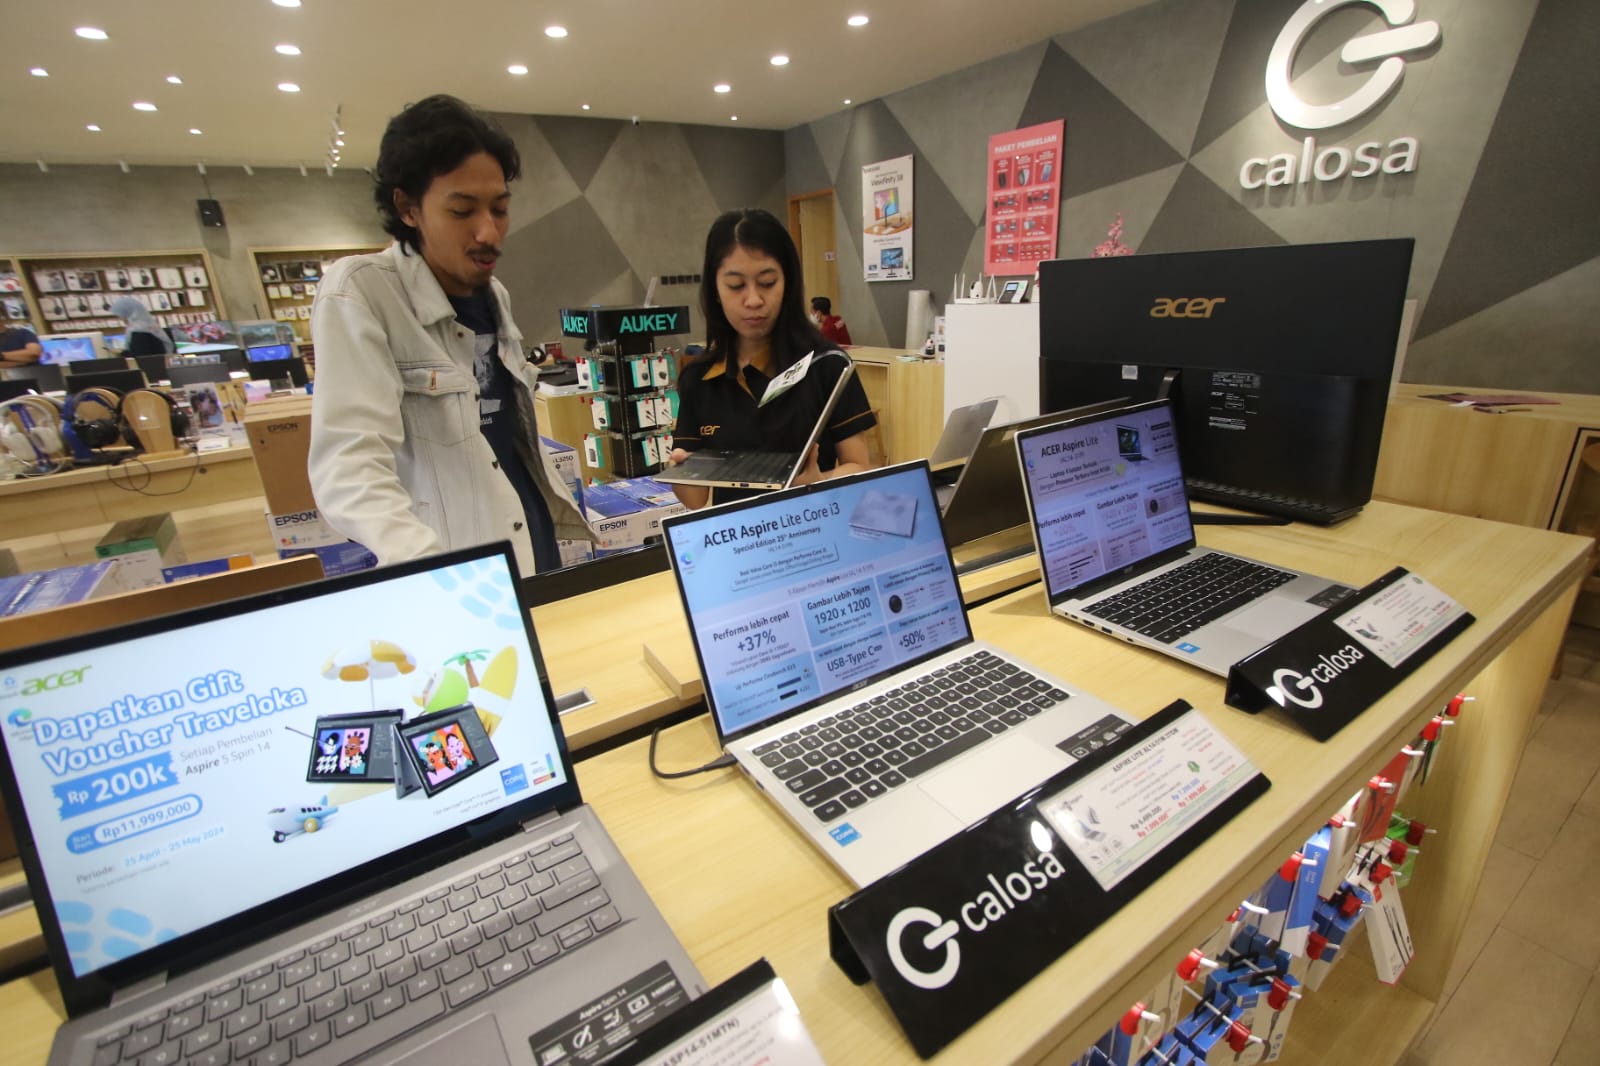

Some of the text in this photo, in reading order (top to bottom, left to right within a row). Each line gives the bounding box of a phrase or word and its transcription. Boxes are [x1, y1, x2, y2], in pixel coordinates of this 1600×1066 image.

[1240, 136, 1418, 189] calosa
[1150, 297, 1226, 318] acer
[563, 315, 589, 334] AUKEY
[619, 313, 678, 334] AUKEY
[267, 422, 298, 433] EPSON
[700, 425, 720, 436] cer
[1041, 442, 1061, 458] ACER
[1062, 438, 1086, 455] Aspire
[1086, 435, 1099, 447] Lite
[275, 511, 318, 526] EPSON
[600, 519, 628, 532] EPSON
[704, 501, 840, 548] ACER Aspire Lite Core i3
[733, 542, 755, 555] Special
[756, 537, 777, 549] Edition
[789, 526, 821, 540] Anniversary
[807, 584, 871, 610] Gambar Lebih Tajam
[814, 608, 839, 625] 1920
[840, 608, 847, 617] x
[849, 597, 871, 614] 1200
[713, 610, 790, 642] Performa lebih cepat
[899, 629, 925, 649] +50%
[738, 629, 776, 653] +37%
[827, 651, 866, 672] USB-Type
[1310, 644, 1365, 684] calosa
[20, 665, 93, 696] acer
[33, 670, 244, 745] Dapatkan Gift
[42, 686, 307, 776] Voucher Traveloka
[180, 727, 273, 762] Setiap Pembelian
[185, 742, 271, 776] Aspire 5 Spin 14
[67, 763, 168, 805] Rp 200k
[102, 801, 192, 839] Rp11,999,000
[139, 848, 161, 863] April
[960, 852, 1066, 932] calosa
